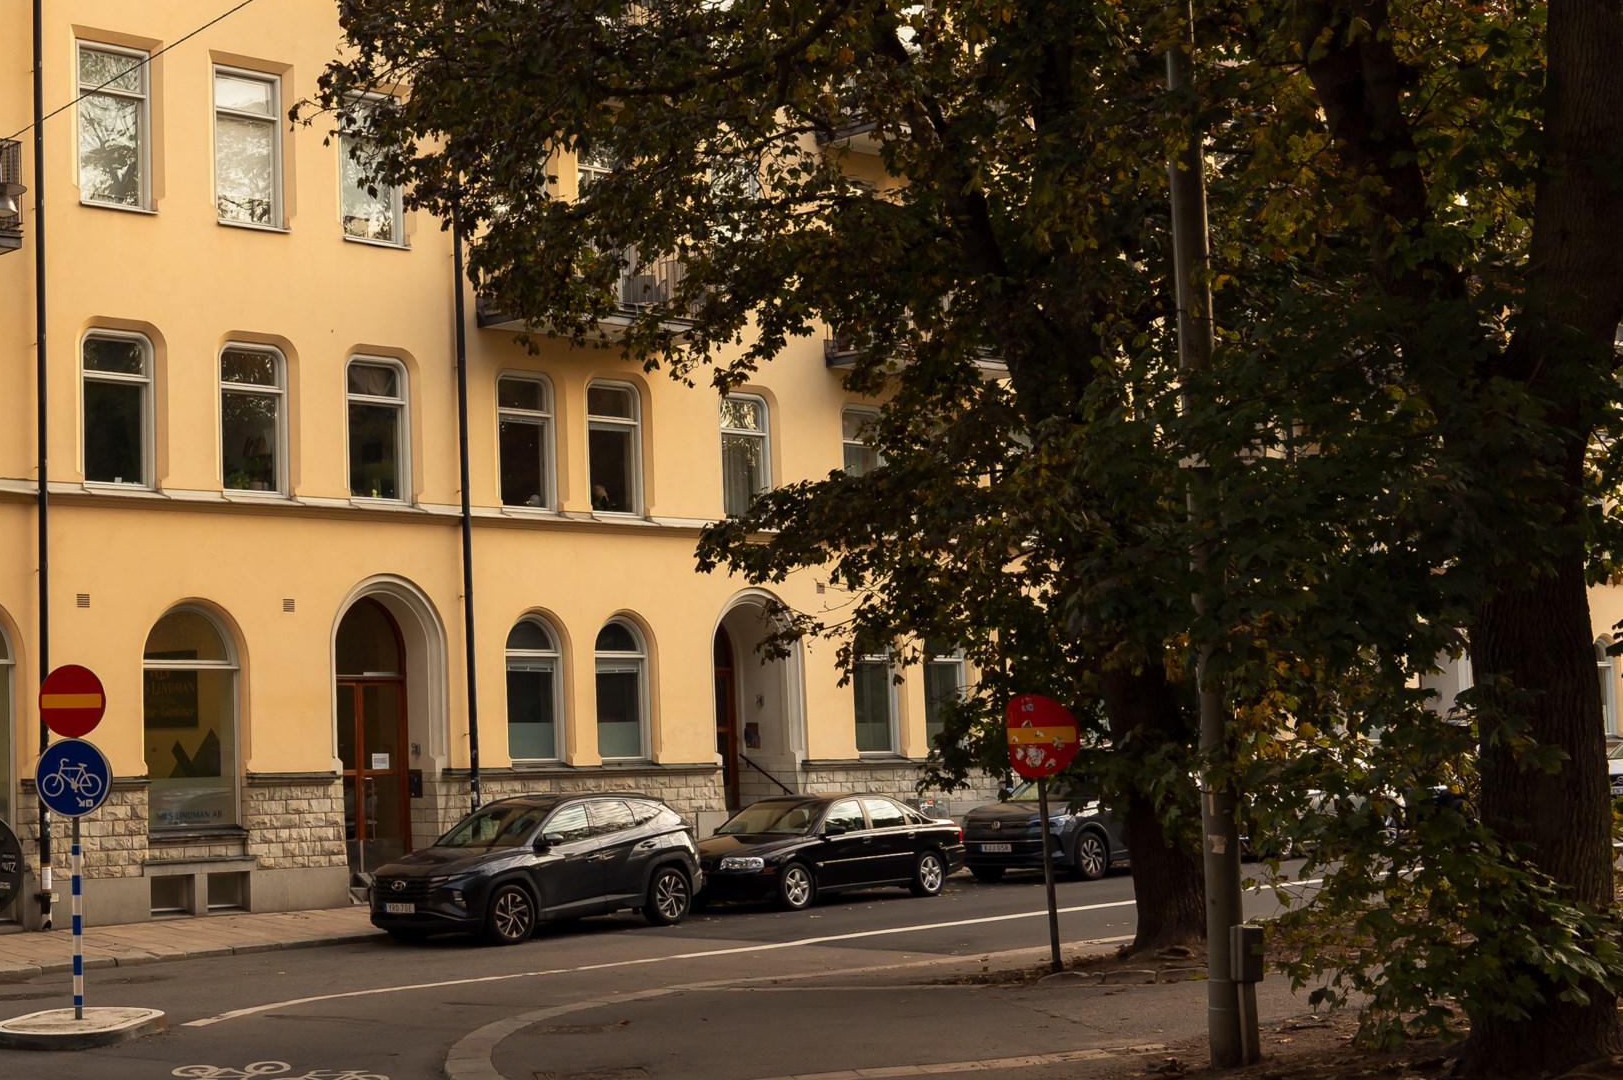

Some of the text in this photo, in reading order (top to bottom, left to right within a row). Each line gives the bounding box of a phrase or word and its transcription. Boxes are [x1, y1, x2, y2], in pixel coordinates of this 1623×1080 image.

[157, 809, 223, 820] NILS LINDMAN AB
